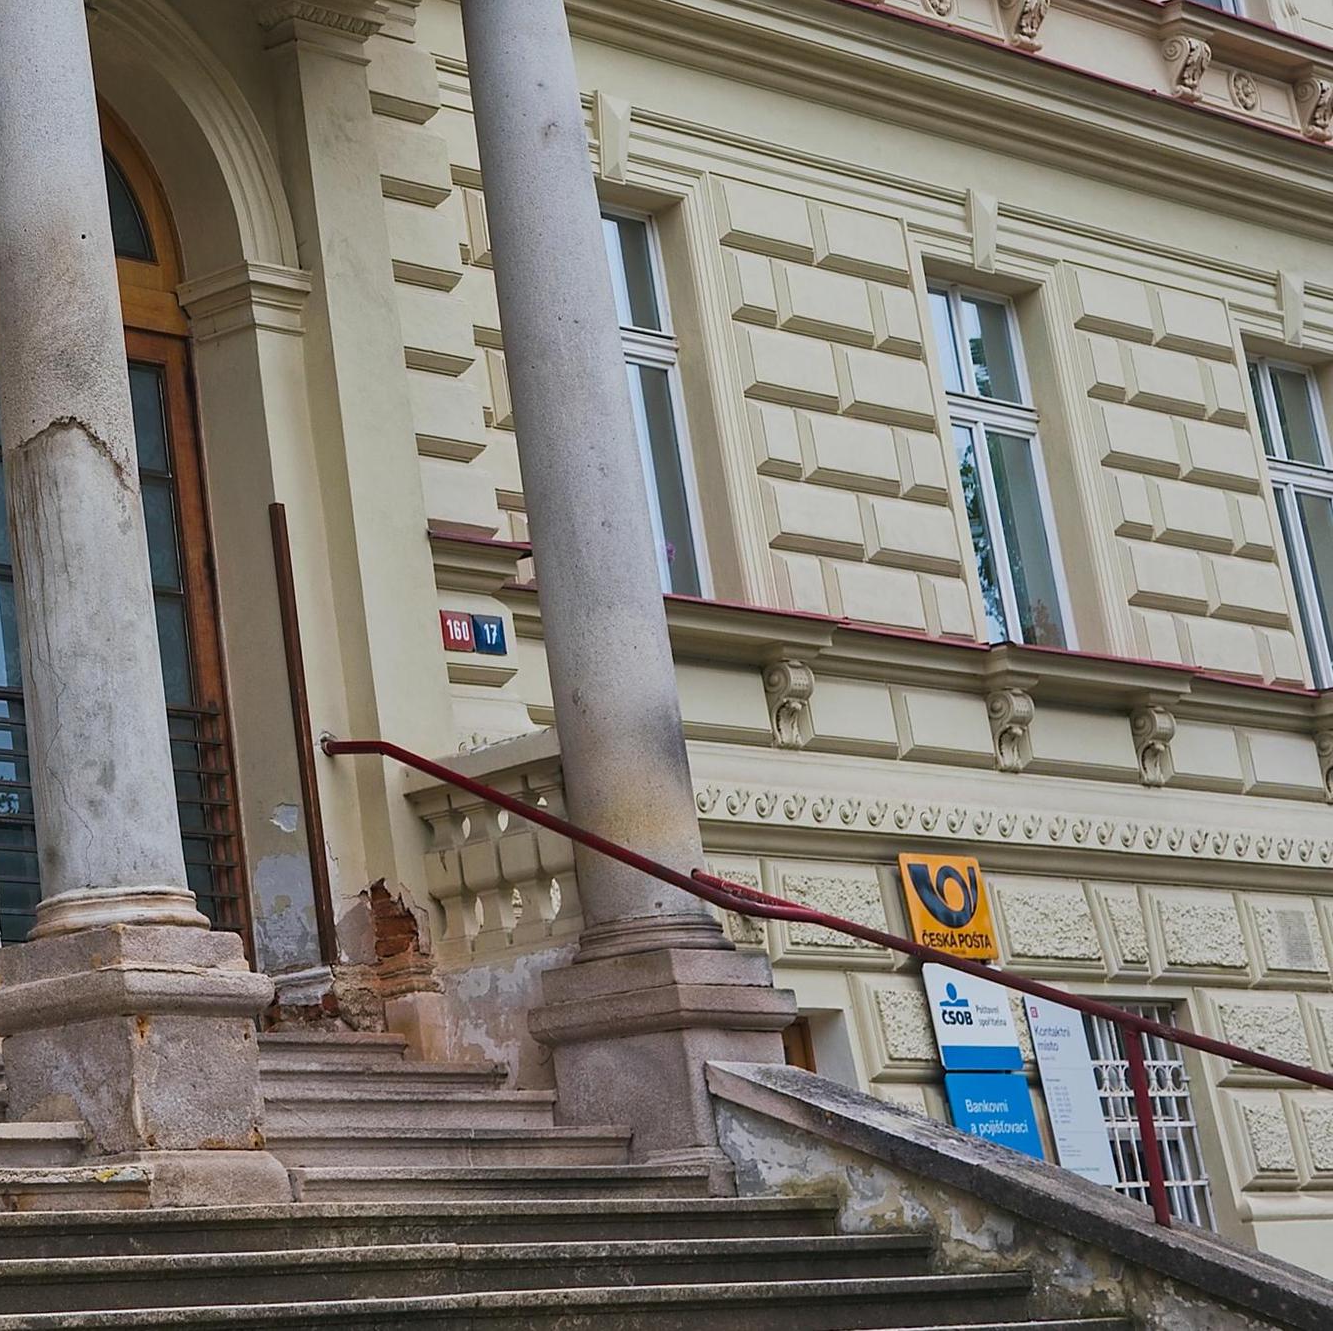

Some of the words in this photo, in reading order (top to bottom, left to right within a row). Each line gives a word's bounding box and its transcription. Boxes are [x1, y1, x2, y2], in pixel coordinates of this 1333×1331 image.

[446, 619, 470, 641] 160
[483, 623, 498, 645] 17
[922, 929, 957, 948] ČESKÁ
[957, 930, 993, 949] POŠTA
[941, 1009, 974, 1026] ČSOB
[970, 1122, 977, 1134] a
